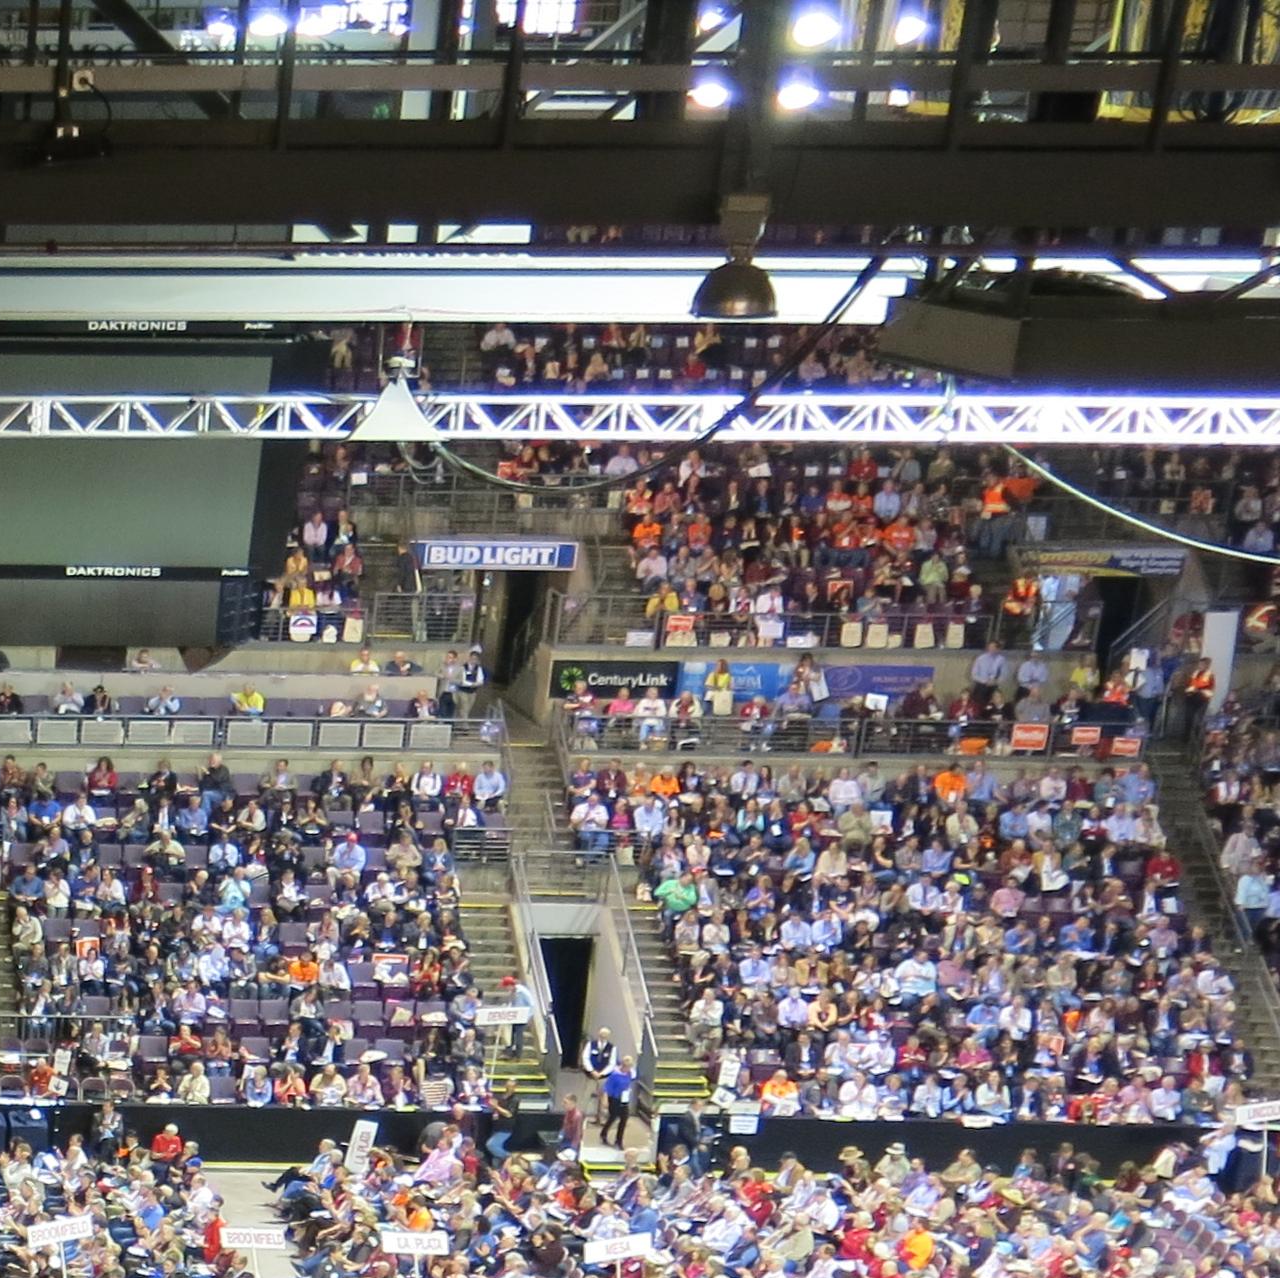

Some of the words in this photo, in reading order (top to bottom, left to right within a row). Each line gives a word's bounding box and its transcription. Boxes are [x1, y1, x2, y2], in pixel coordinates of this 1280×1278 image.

[88, 321, 187, 332] DAKTRONICS
[430, 545, 478, 565] BUD
[478, 545, 553, 565] LIGHT
[66, 566, 161, 577] DAKTRONICS
[588, 672, 668, 688] CenturyLink
[30, 1219, 89, 1243] BROOMFIELD
